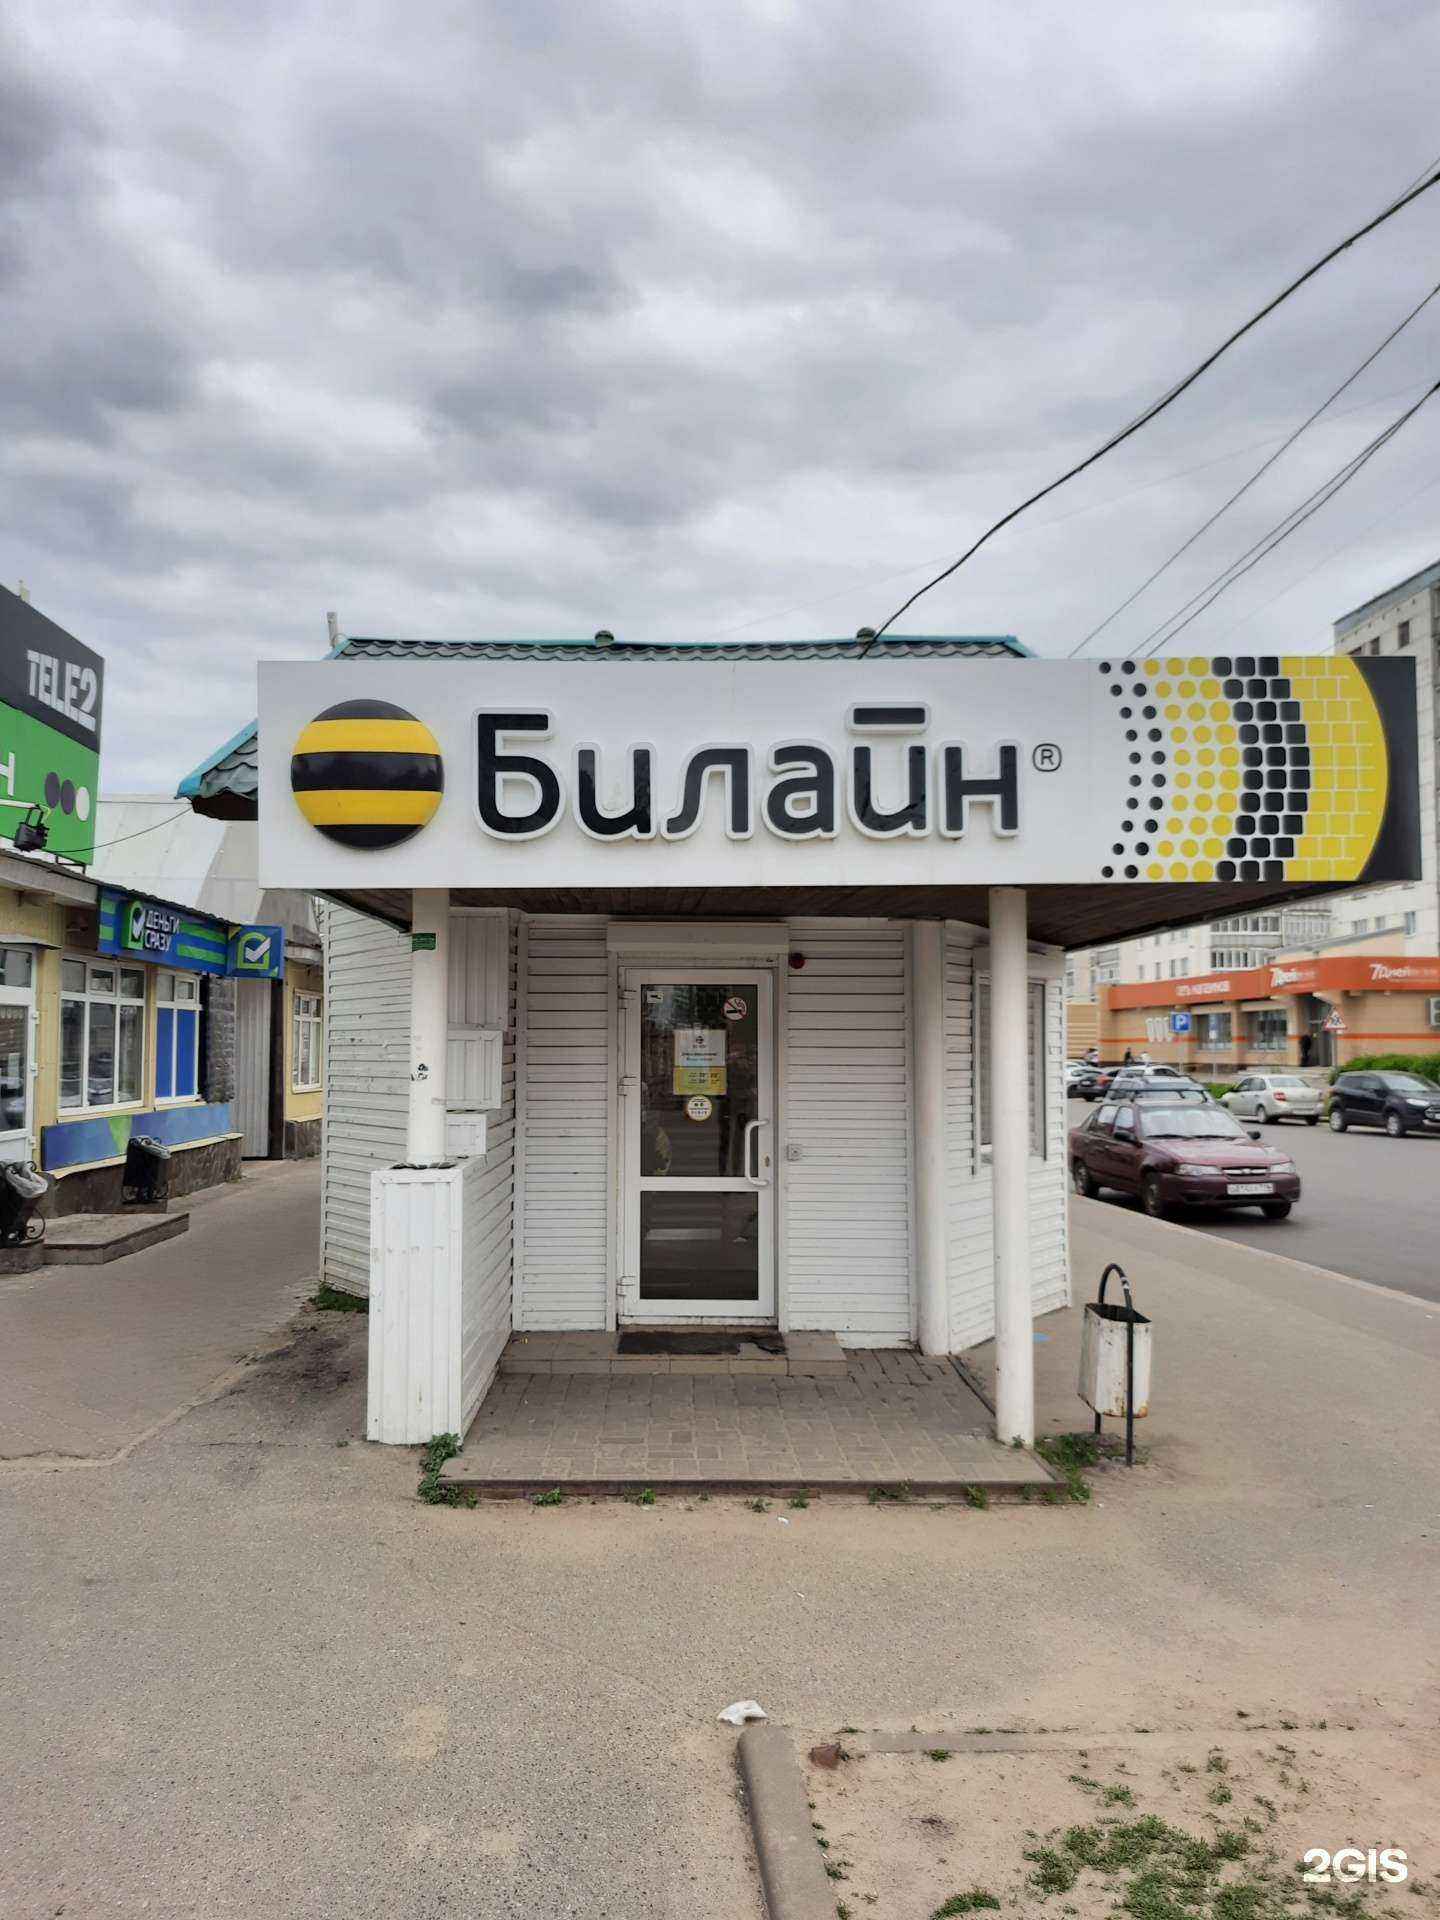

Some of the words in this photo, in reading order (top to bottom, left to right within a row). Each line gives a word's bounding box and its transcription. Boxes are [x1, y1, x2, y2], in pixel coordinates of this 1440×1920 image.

[26, 649, 97, 732] TELE2
[476, 706, 1018, 835] Билайн
[144, 929, 172, 952] СРАЗУ
[145, 910, 180, 934] ДЕНЬГИ
